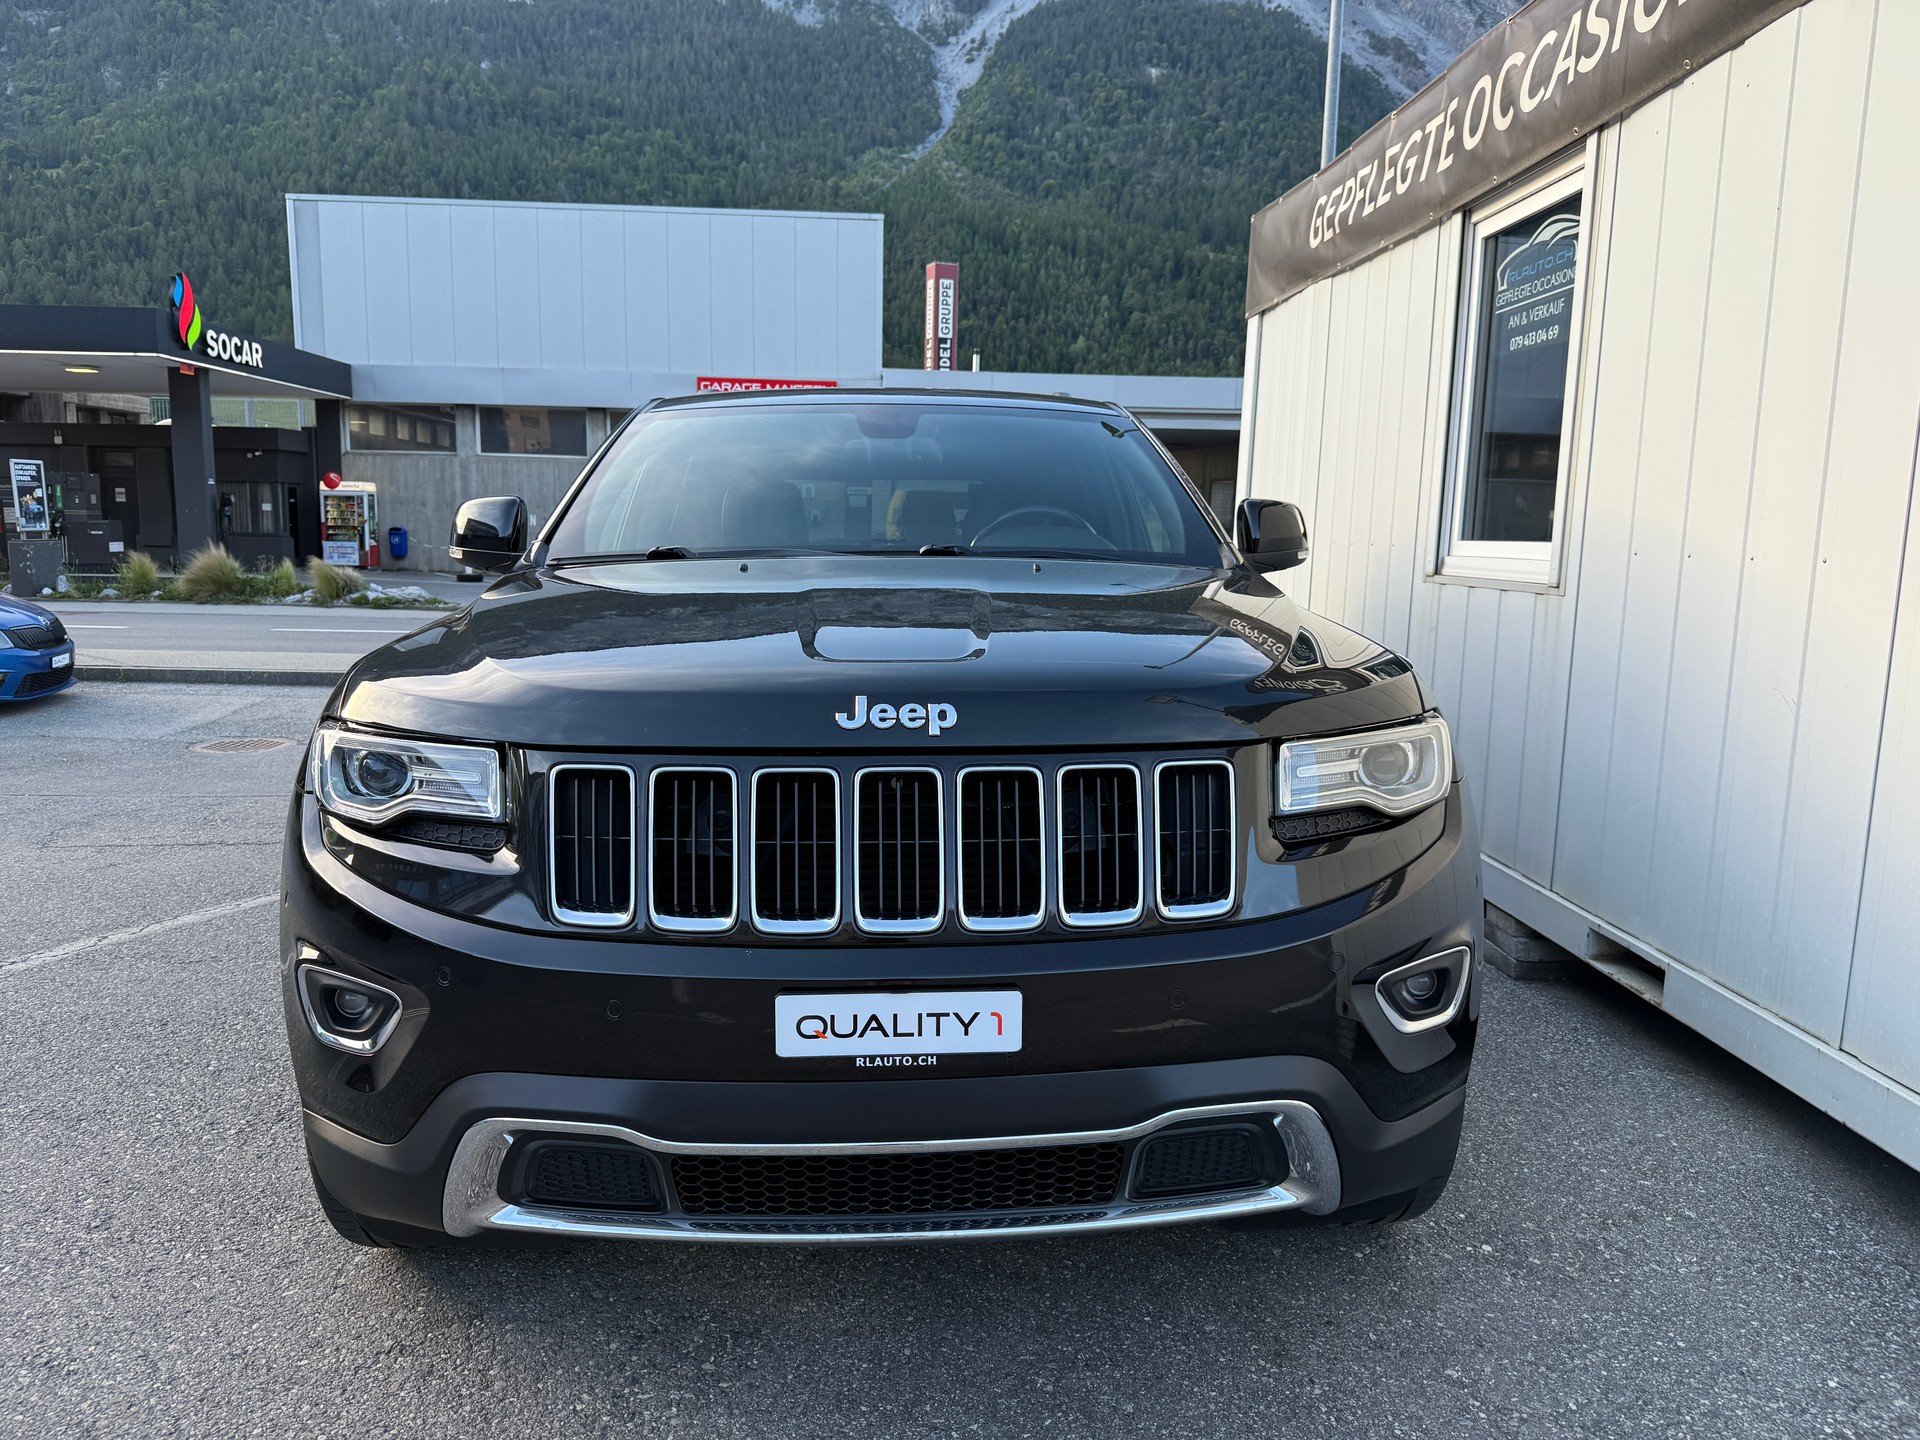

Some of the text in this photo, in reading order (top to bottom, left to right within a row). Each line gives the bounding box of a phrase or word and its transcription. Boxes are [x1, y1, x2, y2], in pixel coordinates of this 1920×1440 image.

[1309, 0, 1687, 249] GEPFLEGTE OCCASI
[1508, 247, 1574, 282] RLAUTO.CH
[941, 281, 952, 335] GRUPPE
[1495, 282, 1532, 307] GEPFLEGTE
[1508, 298, 1566, 329] AN & VERKAUF
[206, 329, 263, 368] SOCAR
[1510, 325, 1559, 350] 079 413 04 69
[835, 696, 958, 736] Jeep
[796, 1011, 1003, 1040] QUALITY 1
[856, 1055, 937, 1067] RLAUTO.CH
